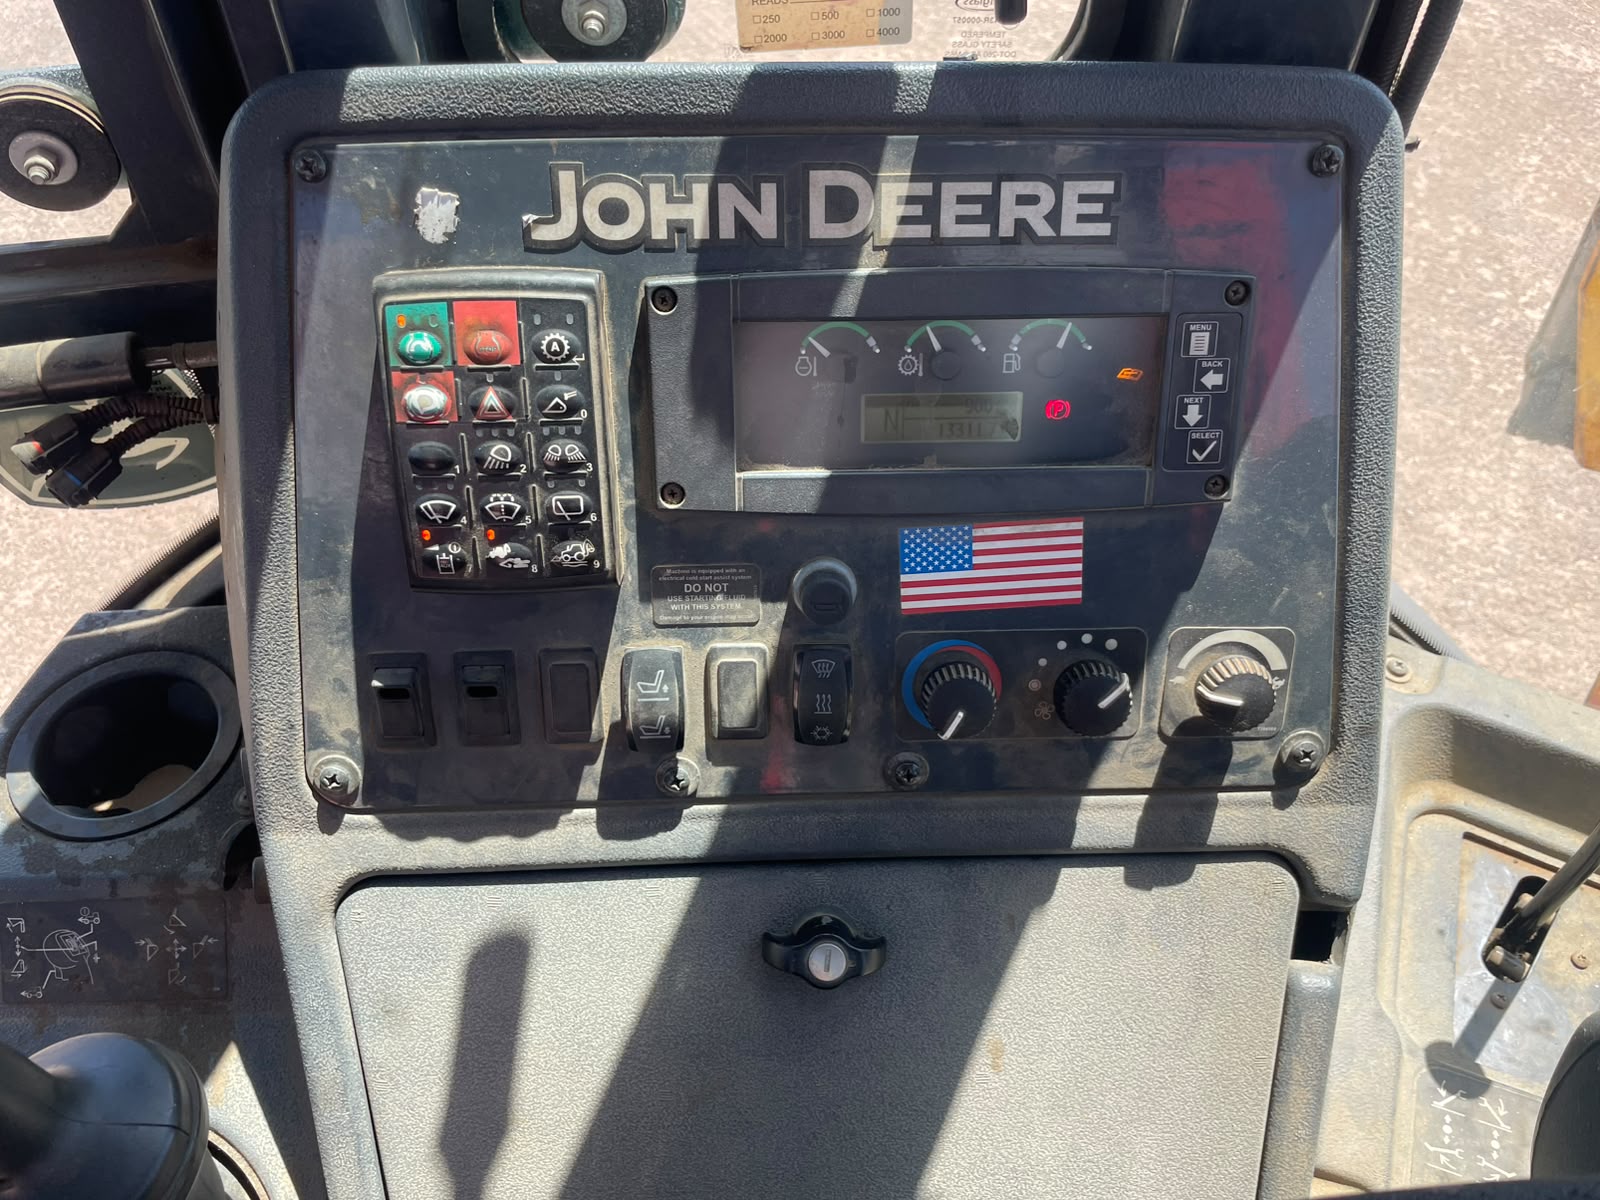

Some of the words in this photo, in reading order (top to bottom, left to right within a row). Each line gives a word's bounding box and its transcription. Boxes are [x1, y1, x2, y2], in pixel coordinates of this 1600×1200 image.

[821, 11, 839, 20] 500
[878, 8, 900, 17] 1000
[762, 15, 780, 24] 250
[821, 31, 845, 40] 3000
[877, 27, 900, 36] 4000
[764, 34, 787, 43] 2000
[530, 170, 778, 242] JOHN
[808, 170, 1114, 239] DEERE
[550, 342, 559, 352] A
[580, 409, 588, 418] 0
[884, 408, 899, 432] N
[455, 465, 460, 473] 1
[520, 464, 527, 473] 2
[586, 463, 593, 472] 3
[460, 516, 467, 524] 4
[525, 516, 532, 524] 5
[590, 513, 597, 521] 6
[531, 564, 538, 573] 8
[593, 560, 600, 568] 9
[684, 583, 701, 593] DO
[705, 583, 729, 592] NOT
